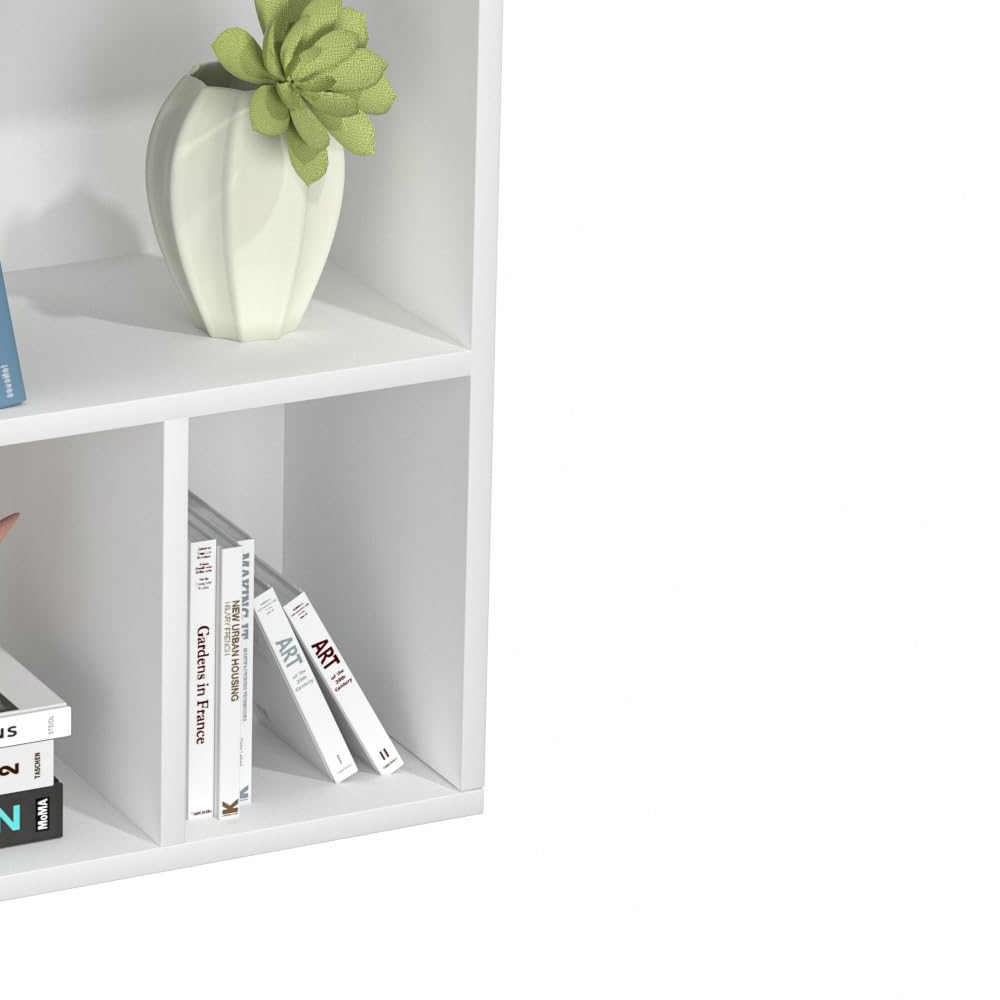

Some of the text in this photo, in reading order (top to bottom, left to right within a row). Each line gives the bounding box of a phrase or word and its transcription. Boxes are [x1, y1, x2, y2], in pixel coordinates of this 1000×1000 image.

[230, 600, 240, 702] NEW URBAN HOUSING
[275, 637, 303, 668] ART
[311, 638, 340, 669] ART
[196, 625, 209, 744] Gardens in France
[36, 798, 48, 831] MoMA
